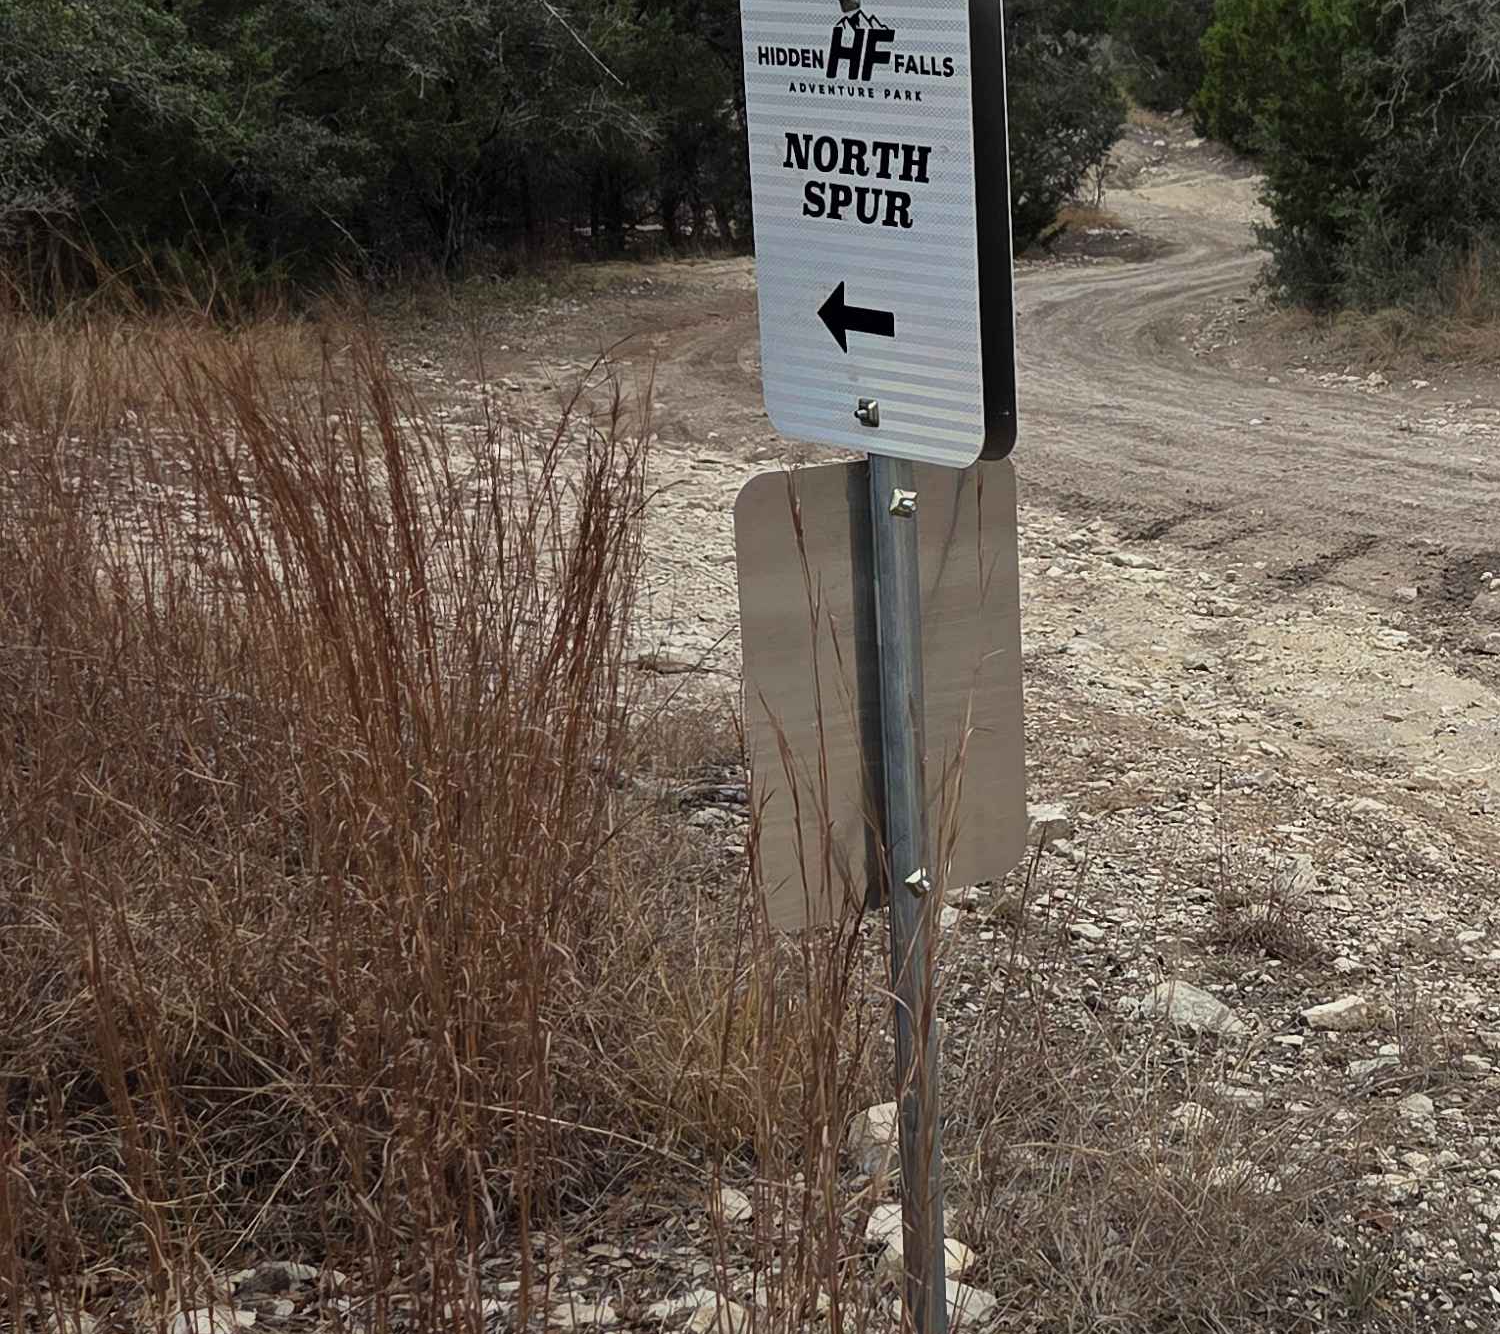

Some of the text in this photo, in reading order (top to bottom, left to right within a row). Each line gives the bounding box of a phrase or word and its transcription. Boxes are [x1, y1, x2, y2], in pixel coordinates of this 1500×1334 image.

[757, 26, 955, 81] HIDDEN HF FALLS
[789, 82, 922, 102] ADVENTURE PARK
[783, 132, 932, 184] NORTH
[802, 180, 913, 229] SPUR
